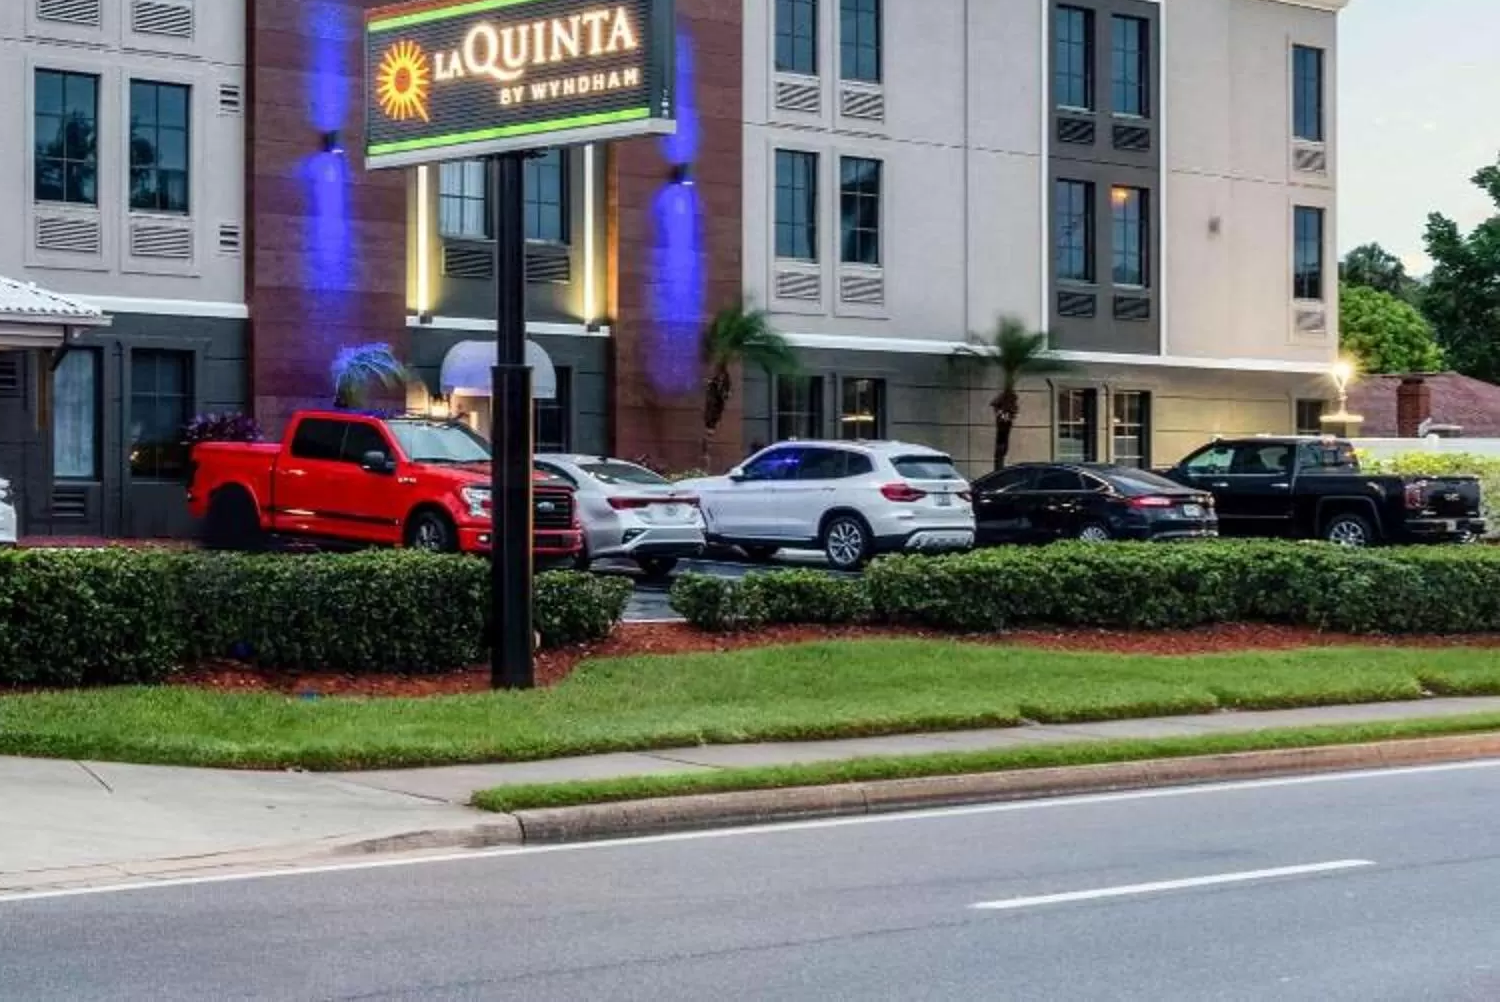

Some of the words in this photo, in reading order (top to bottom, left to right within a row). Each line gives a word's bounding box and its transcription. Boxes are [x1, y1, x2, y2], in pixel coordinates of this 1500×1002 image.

[464, 6, 638, 81] QUINTA
[500, 86, 524, 105] BY
[531, 68, 639, 101] WYNDHAM
